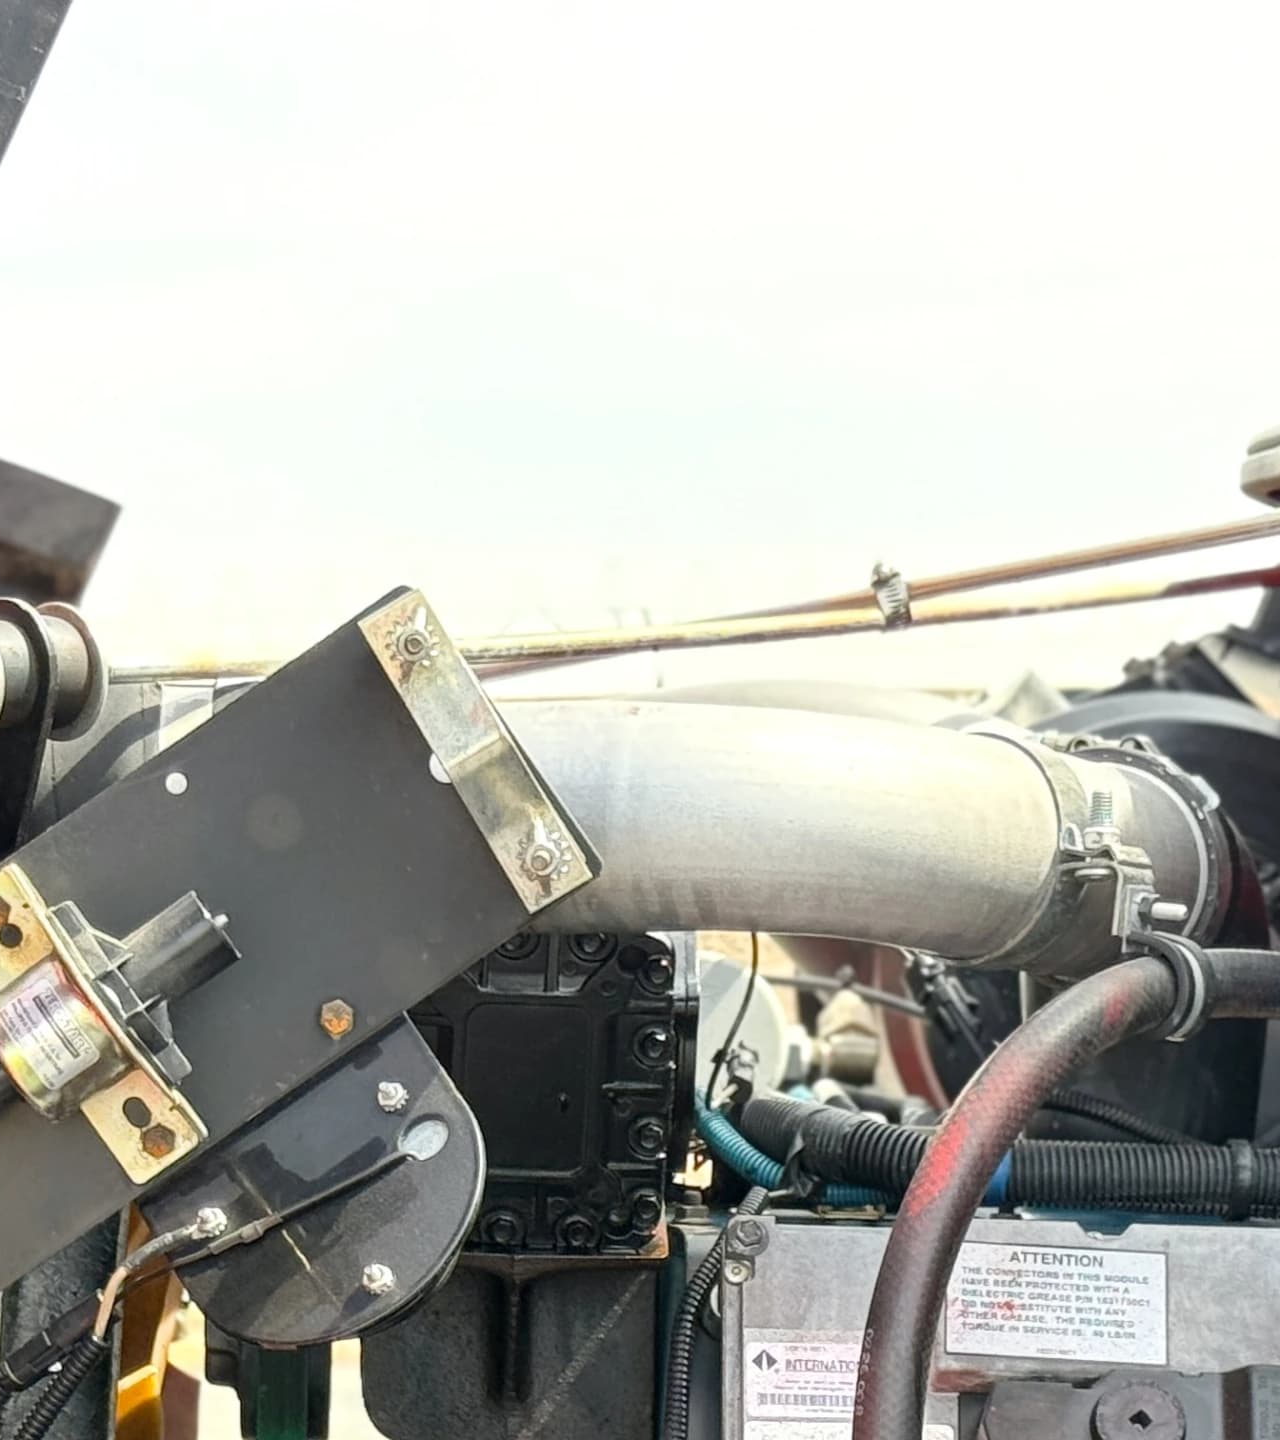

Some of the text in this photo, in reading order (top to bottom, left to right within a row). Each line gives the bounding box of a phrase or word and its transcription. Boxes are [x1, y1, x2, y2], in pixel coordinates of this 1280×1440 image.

[1009, 1251, 1104, 1268] ATTENTION
[961, 1266, 983, 1275] THE
[1077, 1272, 1101, 1282] THIS
[1104, 1274, 1150, 1285] MODULE
[1025, 1281, 1090, 1292] PROTECTED
[1093, 1285, 1120, 1294] WITH
[1027, 1291, 1073, 1302] GREASE
[786, 1359, 860, 1373] INTERNATIO
